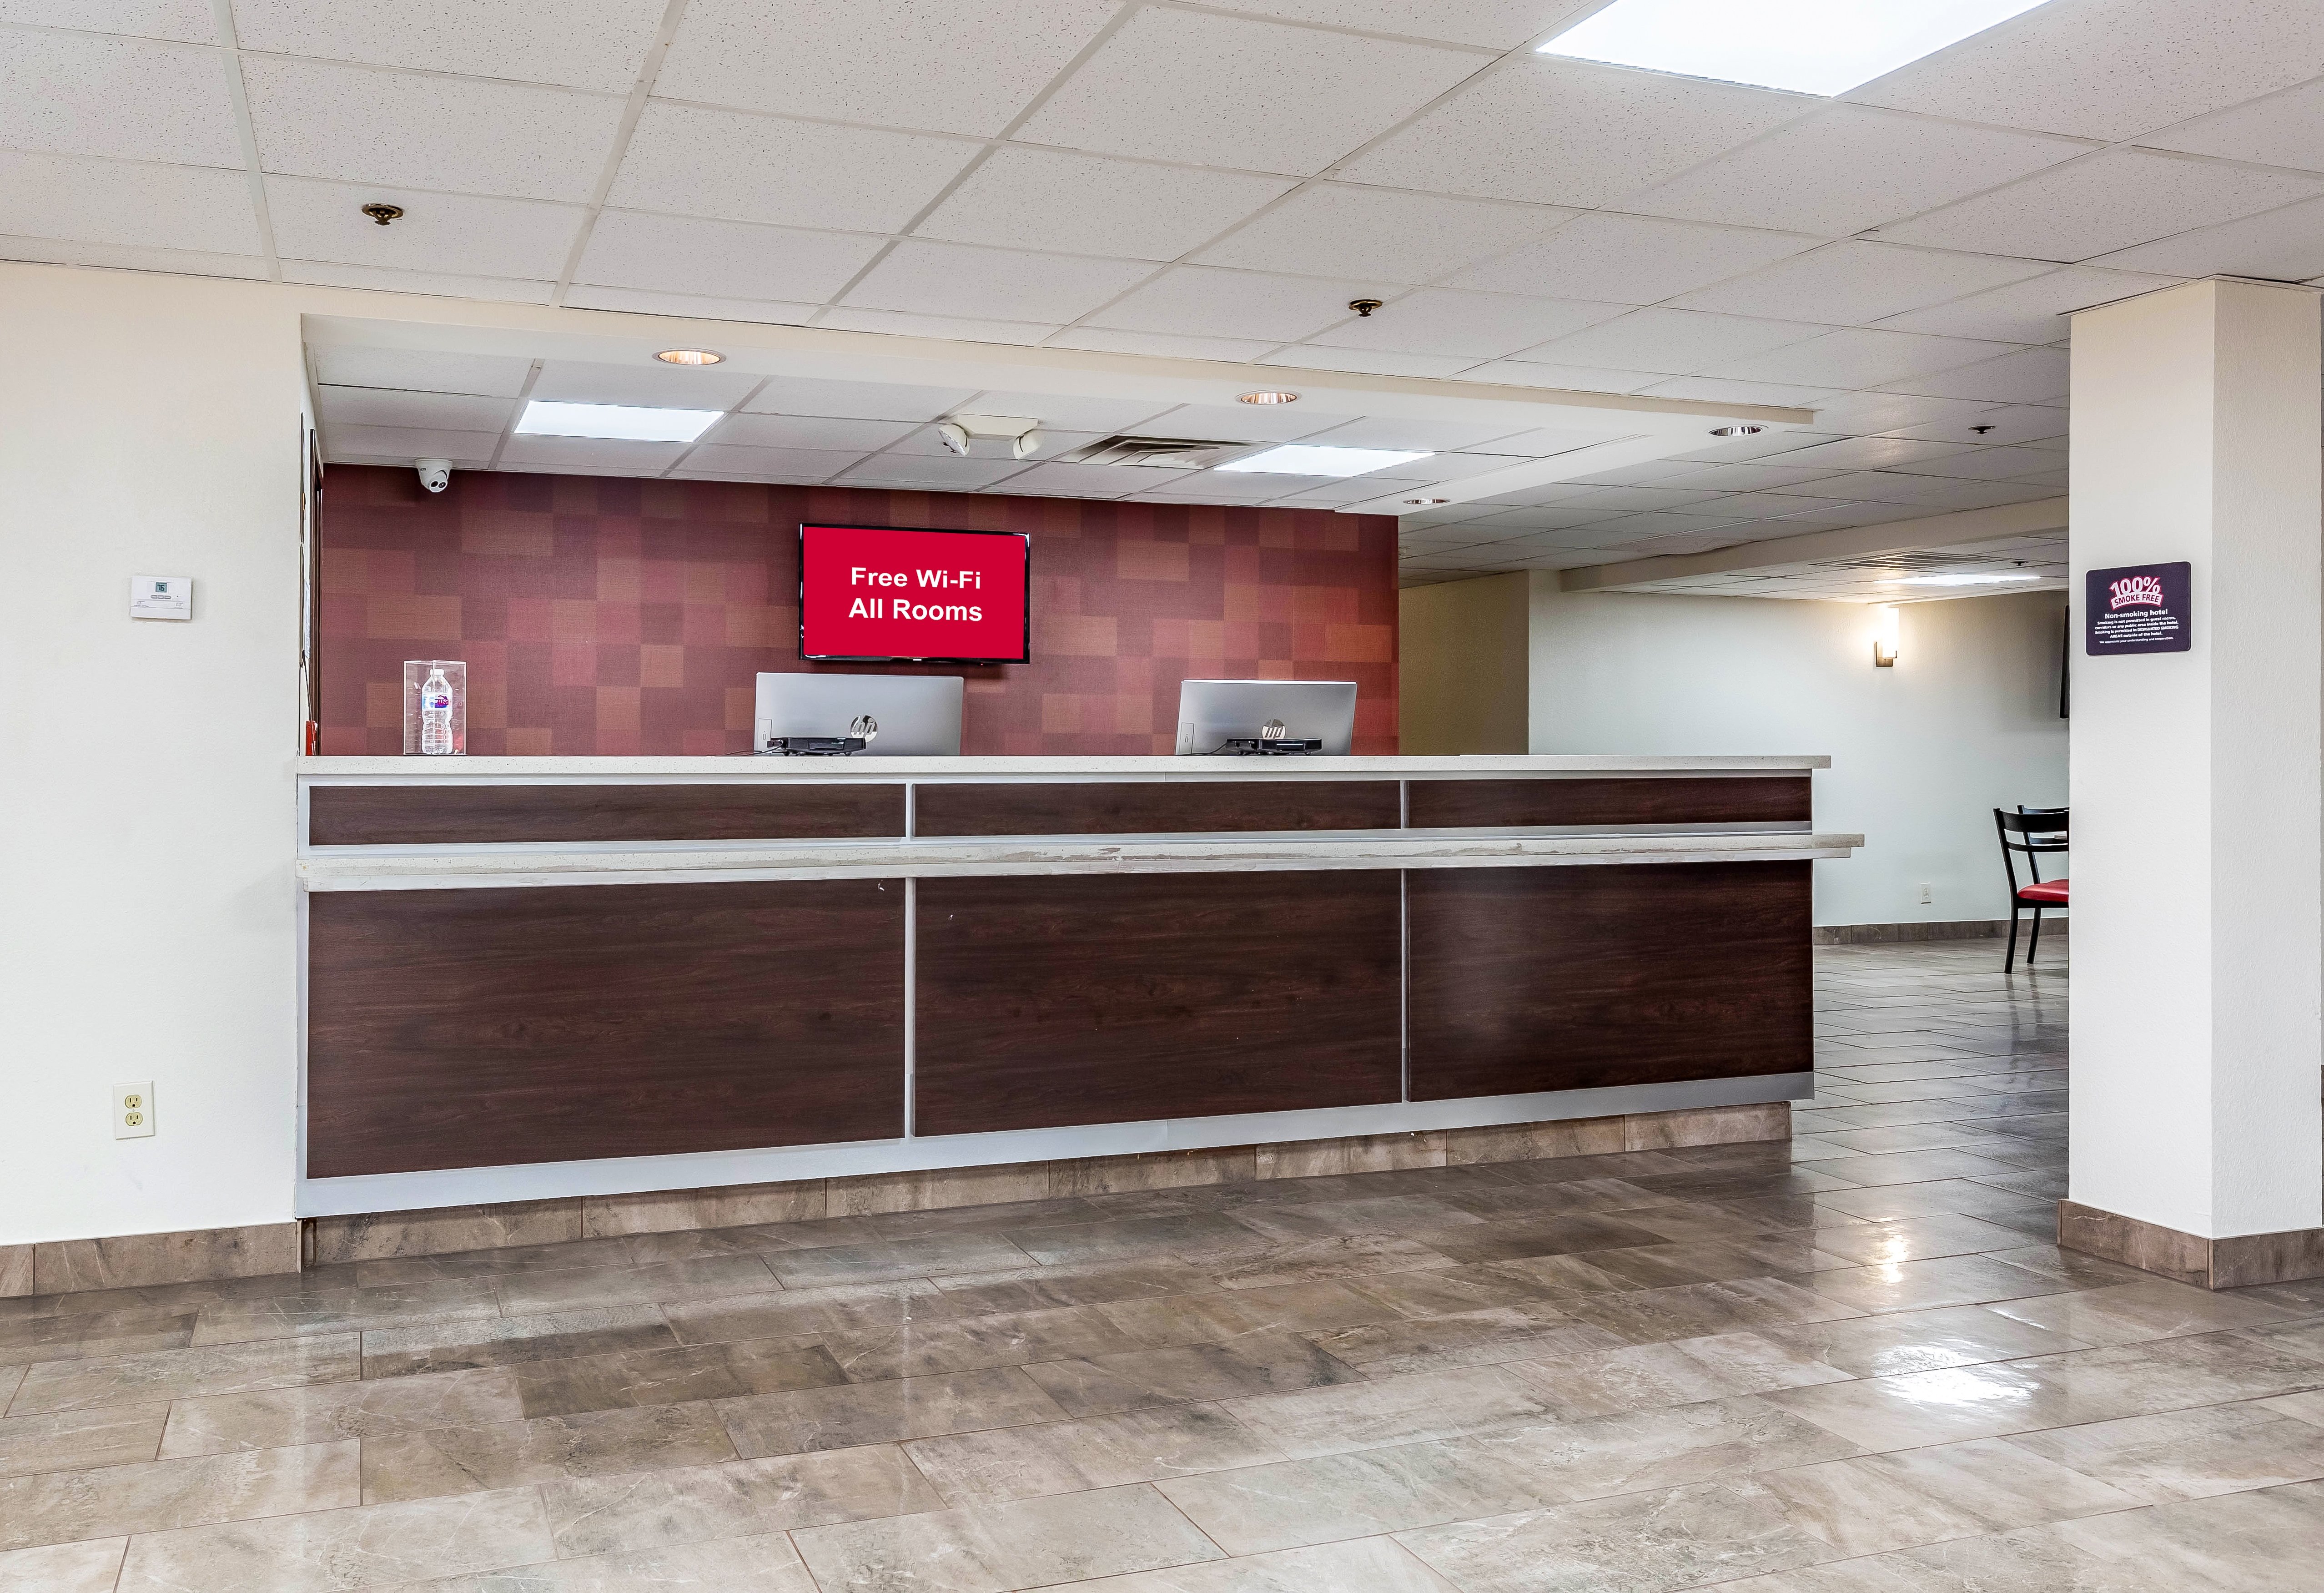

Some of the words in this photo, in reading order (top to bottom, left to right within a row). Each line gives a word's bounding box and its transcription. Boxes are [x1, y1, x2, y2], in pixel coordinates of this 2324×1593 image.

[851, 567, 907, 586] Free
[916, 569, 981, 589] Wi-Fi
[2110, 577, 2160, 596] 100%
[849, 598, 883, 618] All
[893, 599, 982, 621] Rooms
[2114, 594, 2140, 605] SMOKE
[2142, 594, 2159, 602] FREE
